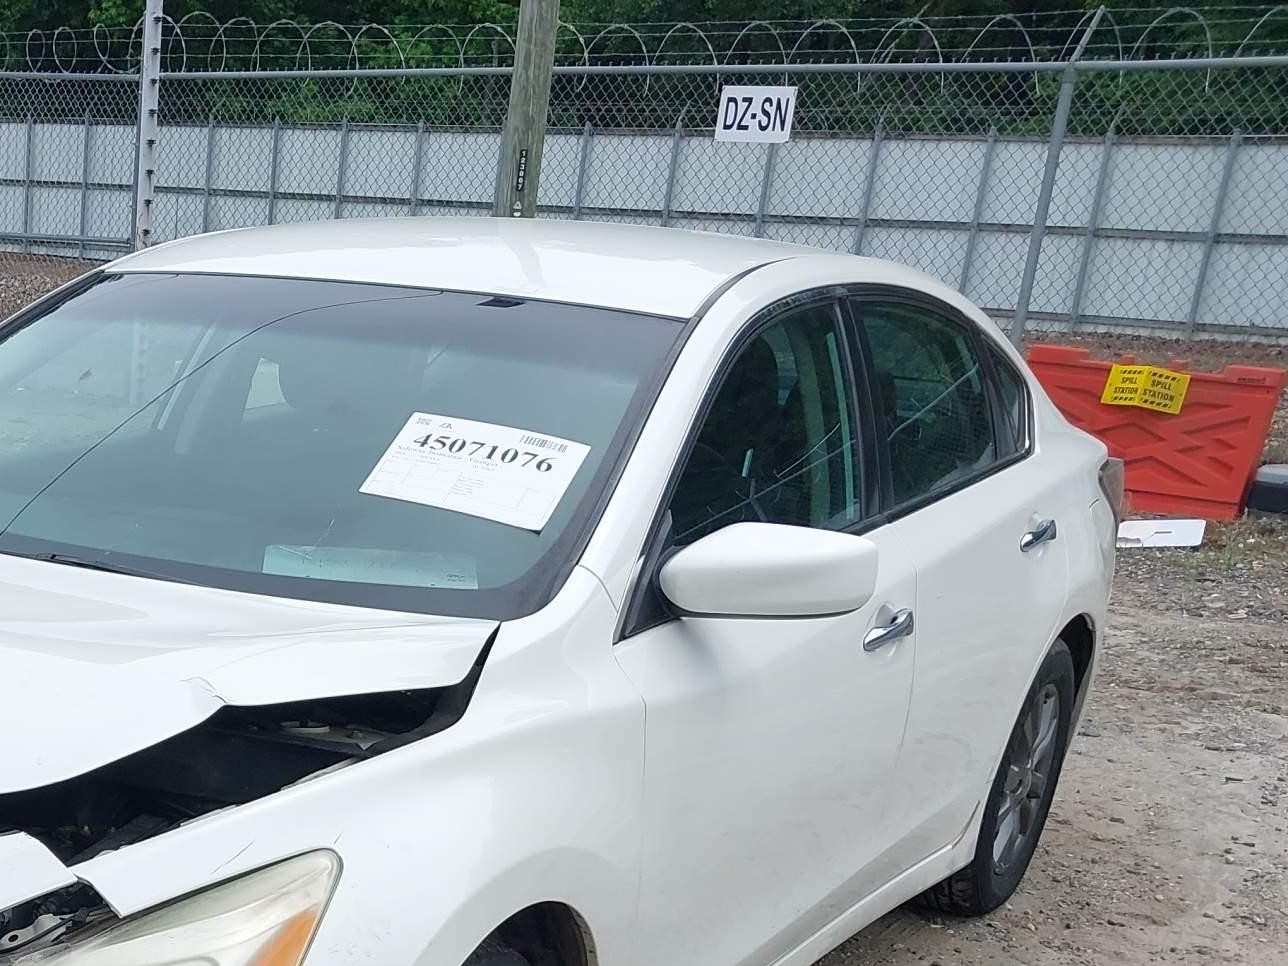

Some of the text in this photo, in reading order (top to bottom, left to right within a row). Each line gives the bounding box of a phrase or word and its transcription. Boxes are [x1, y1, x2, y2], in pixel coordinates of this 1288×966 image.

[722, 96, 791, 132] DZ-SN
[1120, 376, 1138, 385] SPILL
[1150, 379, 1172, 392] SPILL
[1142, 388, 1175, 402] STATION
[413, 432, 558, 473] 45071076
